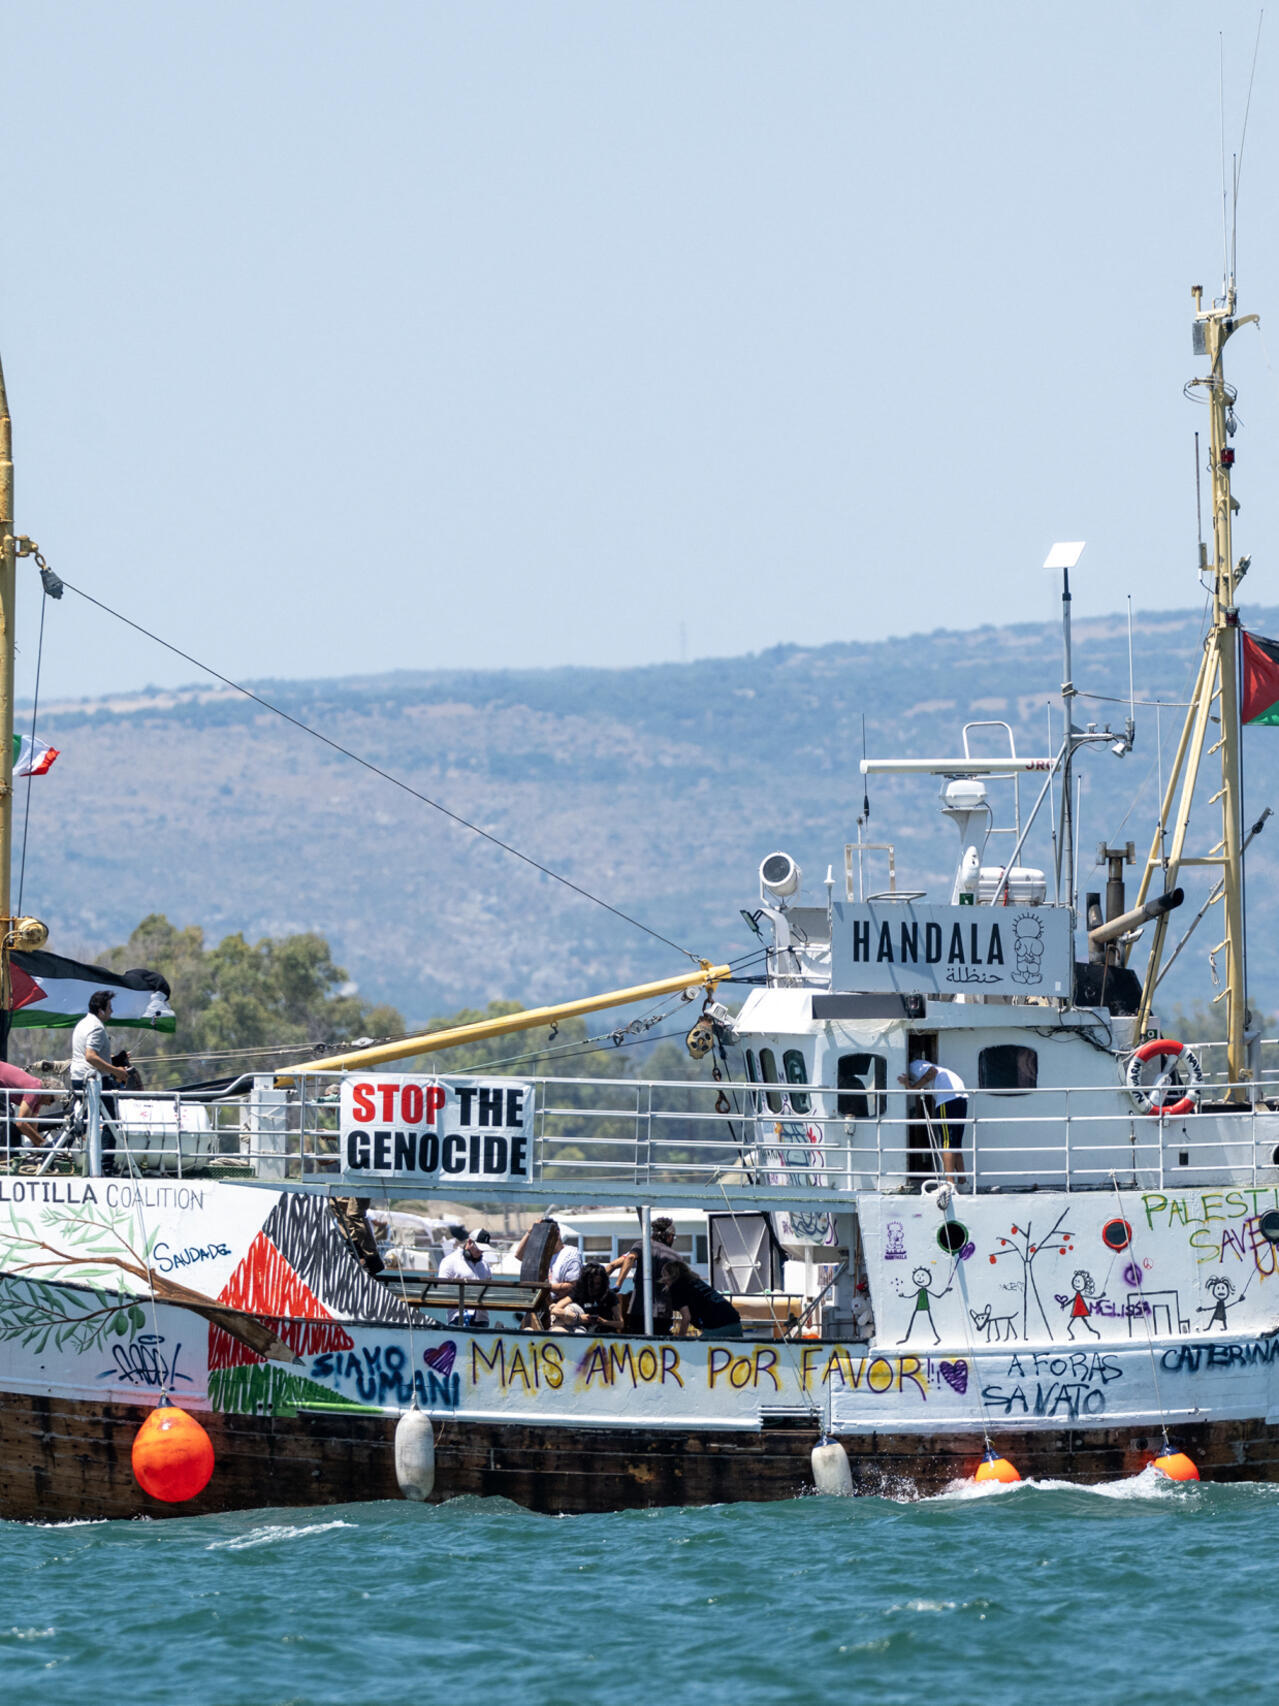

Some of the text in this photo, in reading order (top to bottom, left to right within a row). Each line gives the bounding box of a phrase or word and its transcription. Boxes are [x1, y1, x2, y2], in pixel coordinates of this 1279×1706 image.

[853, 920, 1004, 965] HANDALA
[946, 966, 1004, 984] حنظلة
[352, 1083, 524, 1128] STOP THE
[347, 1130, 528, 1175] GENOCIDE
[106, 1183, 204, 1210] COALITION
[584, 1342, 684, 1389] AMOR
[710, 1348, 778, 1391] POR
[1007, 1353, 1026, 1377] A
